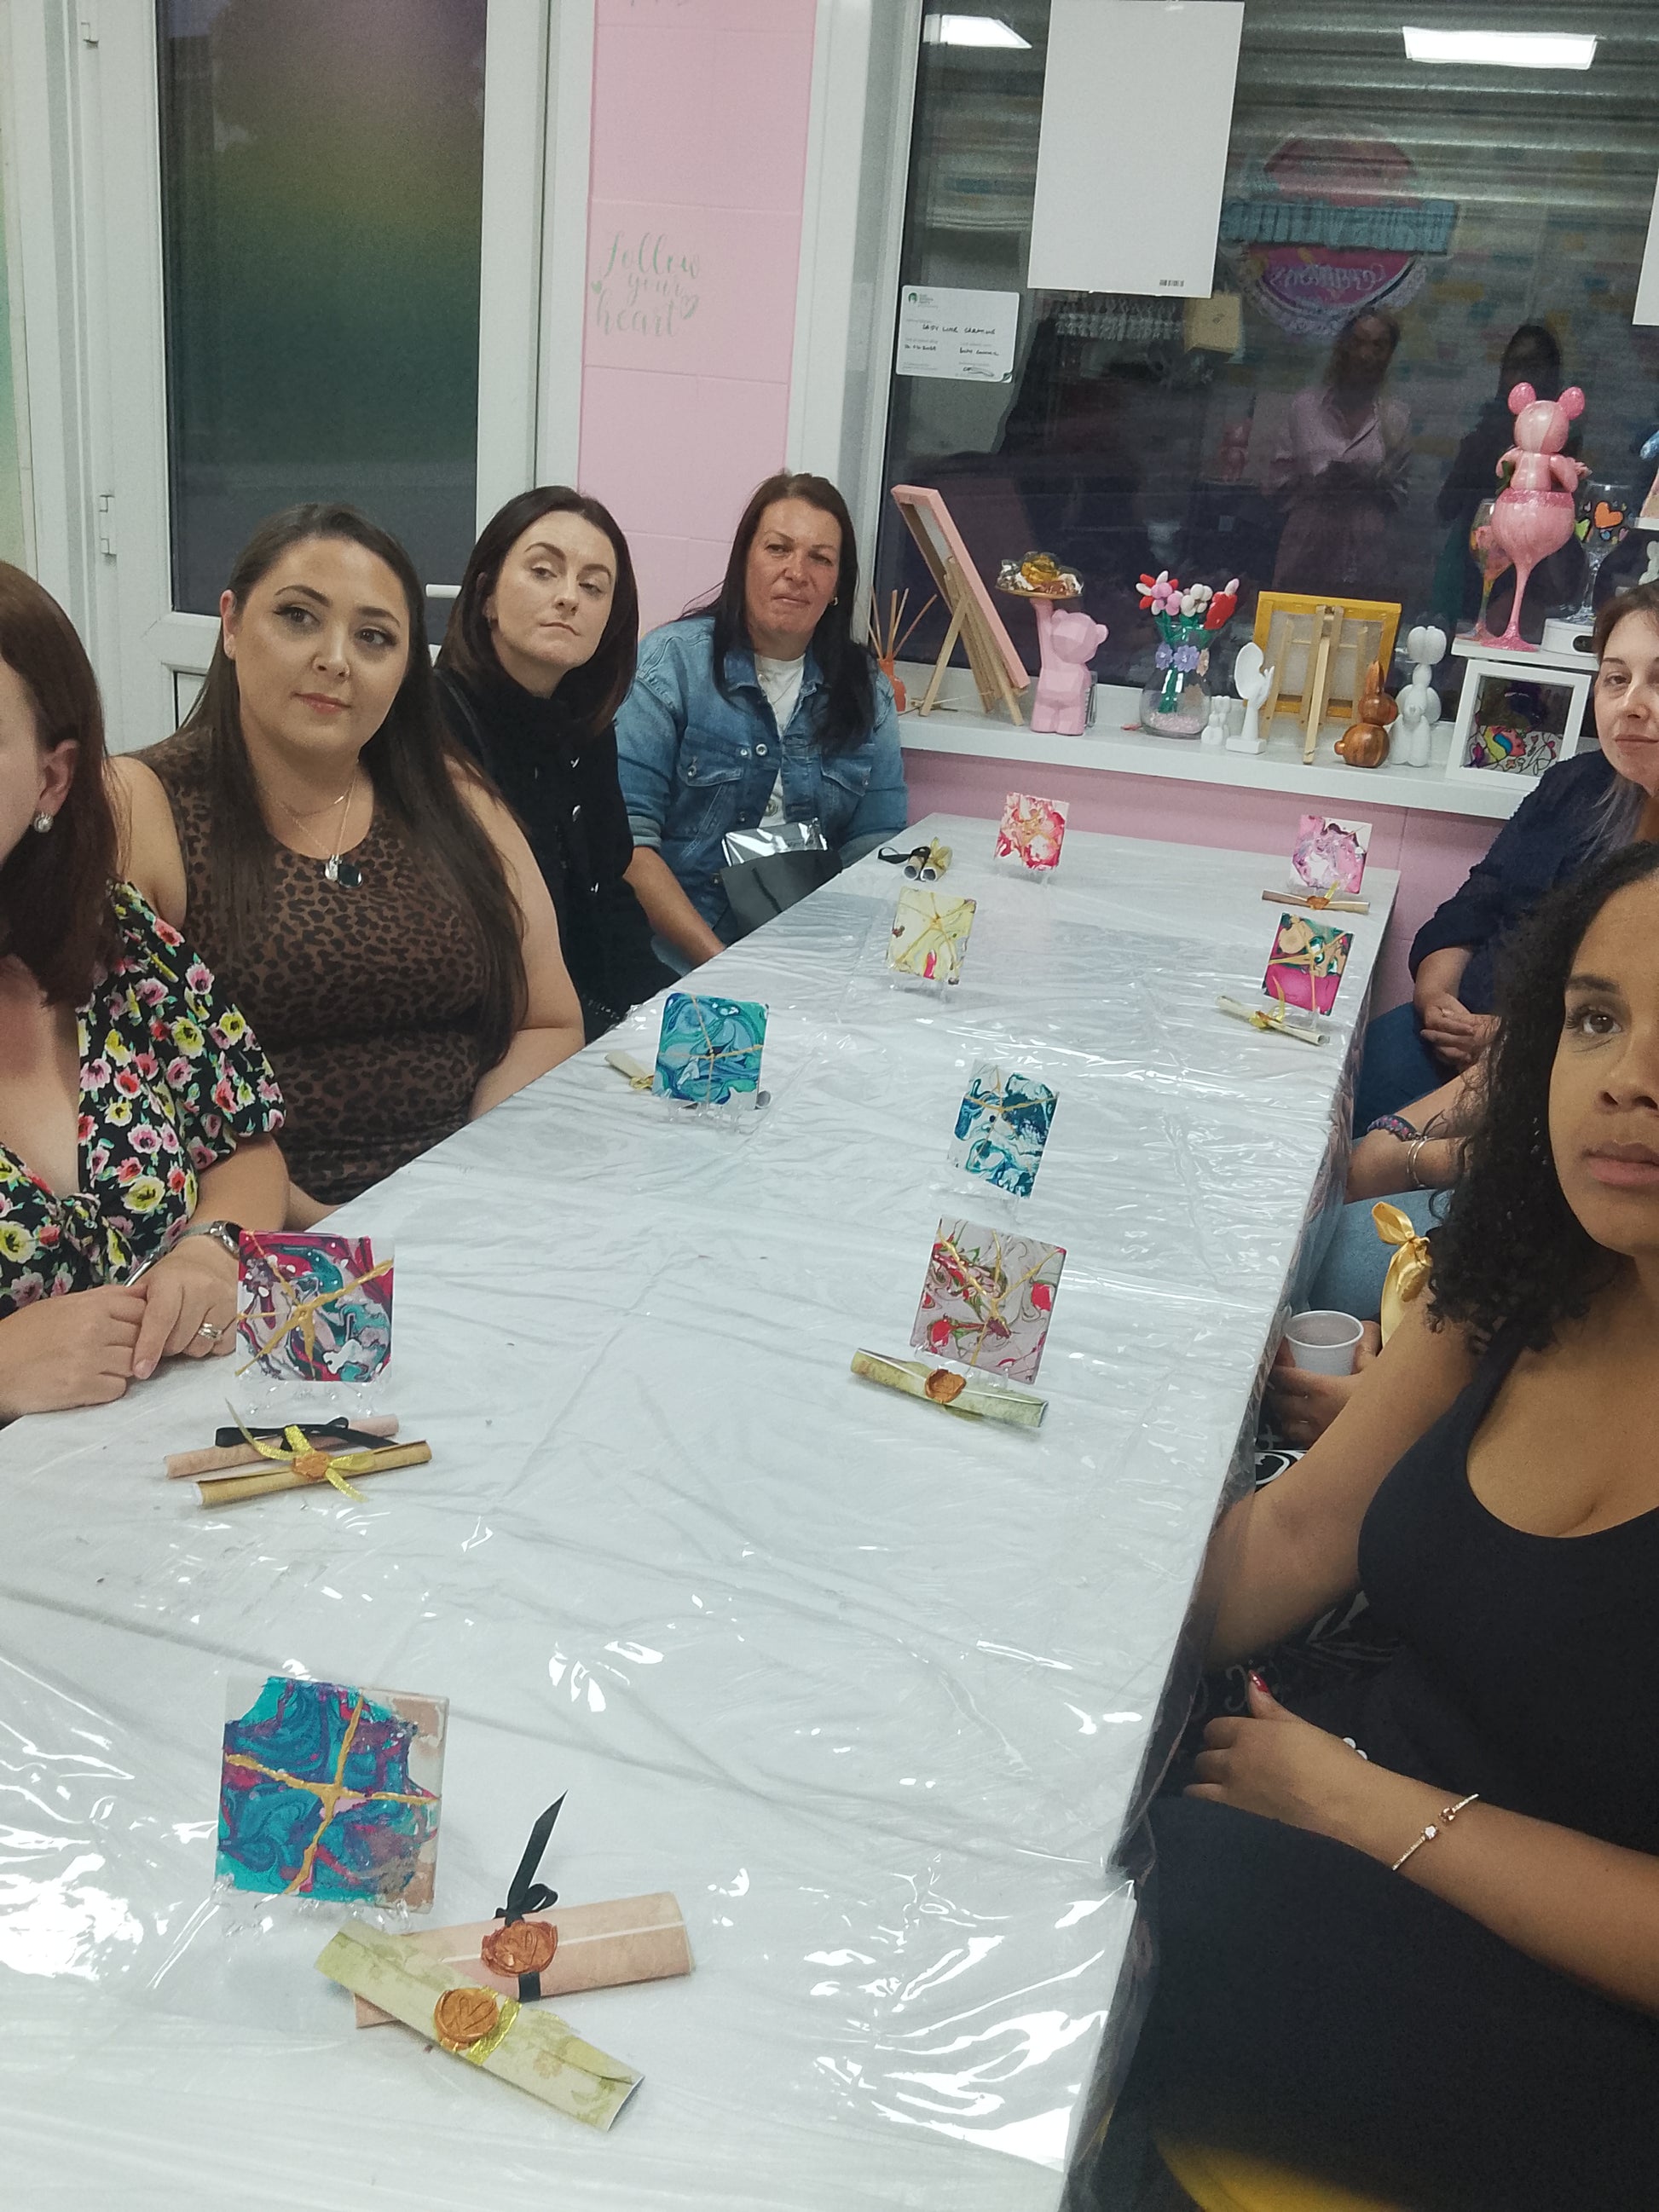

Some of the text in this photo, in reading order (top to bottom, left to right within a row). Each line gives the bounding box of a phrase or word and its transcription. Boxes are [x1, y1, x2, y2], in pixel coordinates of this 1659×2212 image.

[604, 231, 699, 279] follow
[597, 289, 676, 336] heart
[627, 273, 684, 307] your
